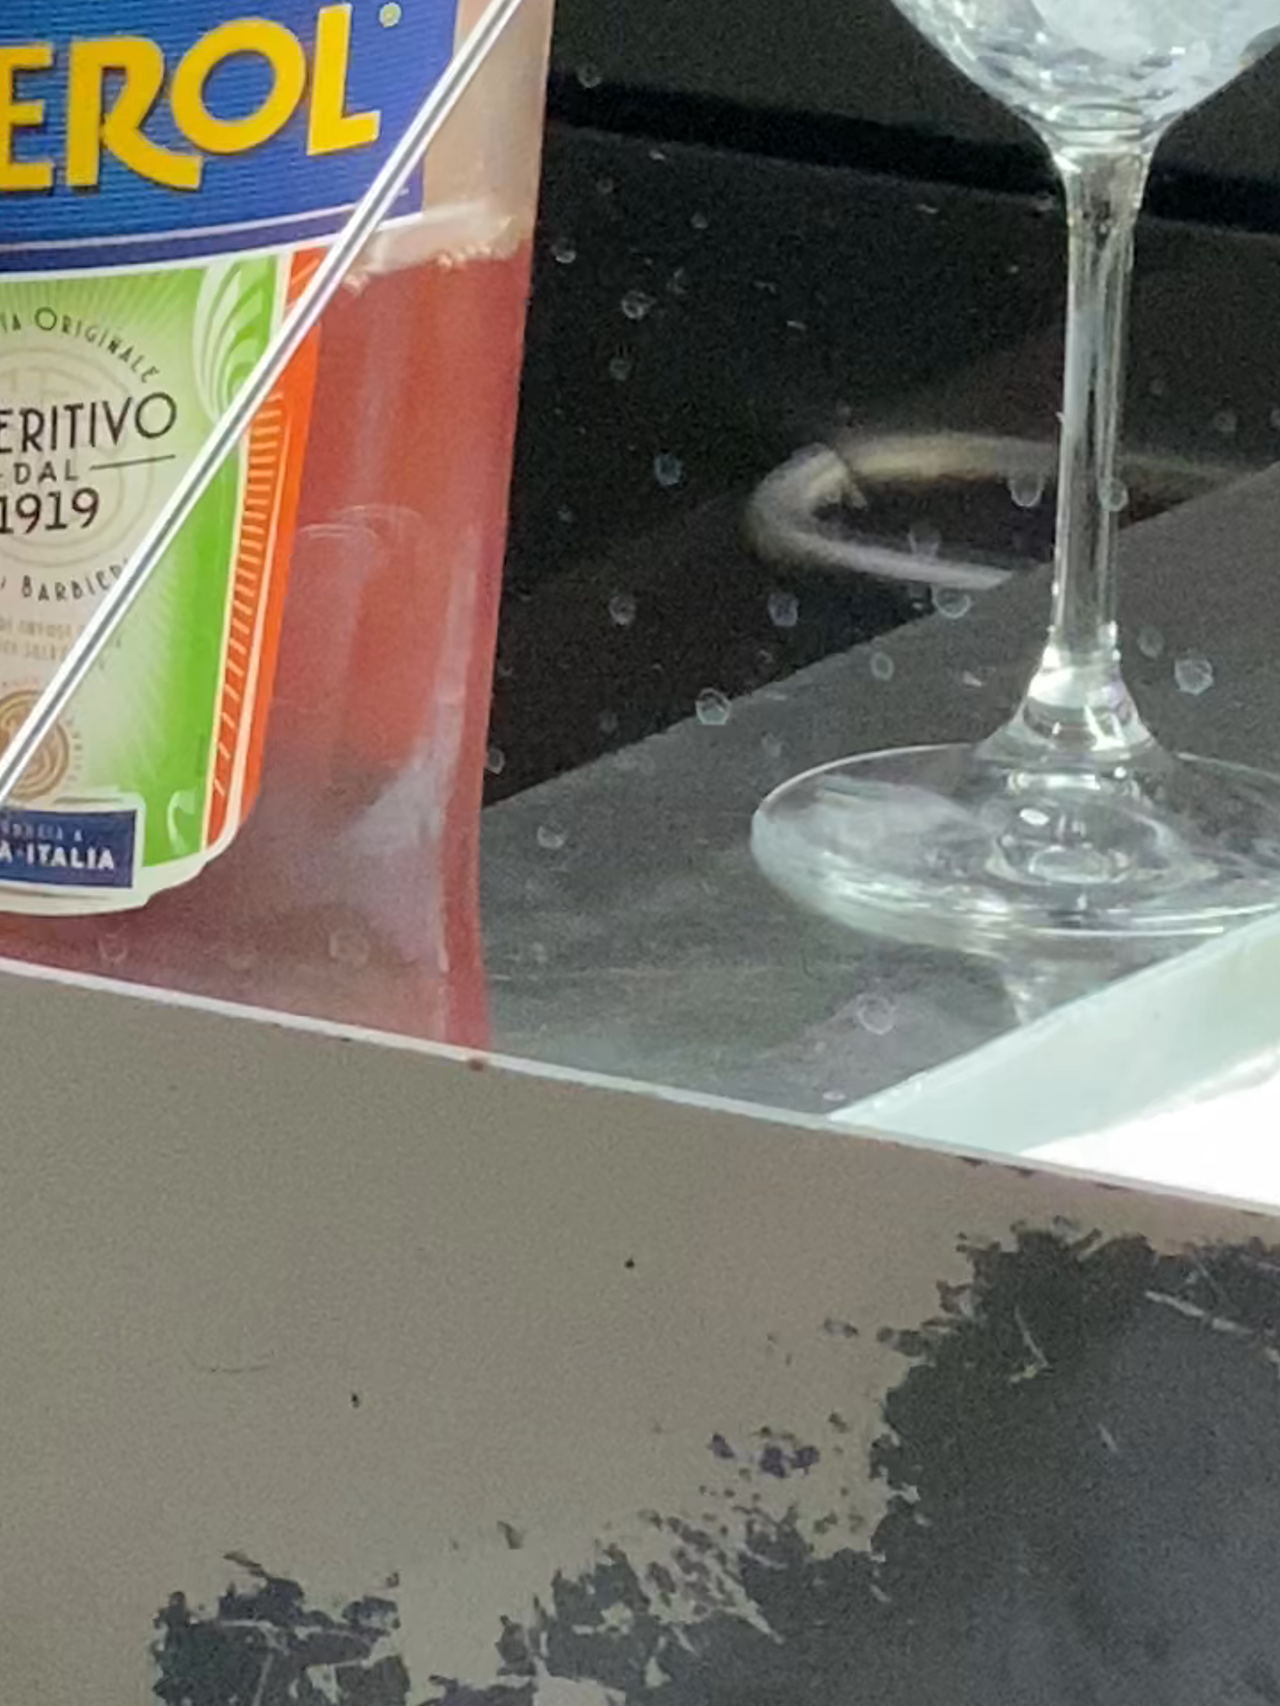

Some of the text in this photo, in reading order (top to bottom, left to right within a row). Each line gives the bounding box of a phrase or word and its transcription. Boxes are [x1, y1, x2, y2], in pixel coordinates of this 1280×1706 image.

[34, 306, 160, 383] ORIGINALE
[13, 459, 80, 486] DAL
[22, 557, 129, 603] BARBIER
